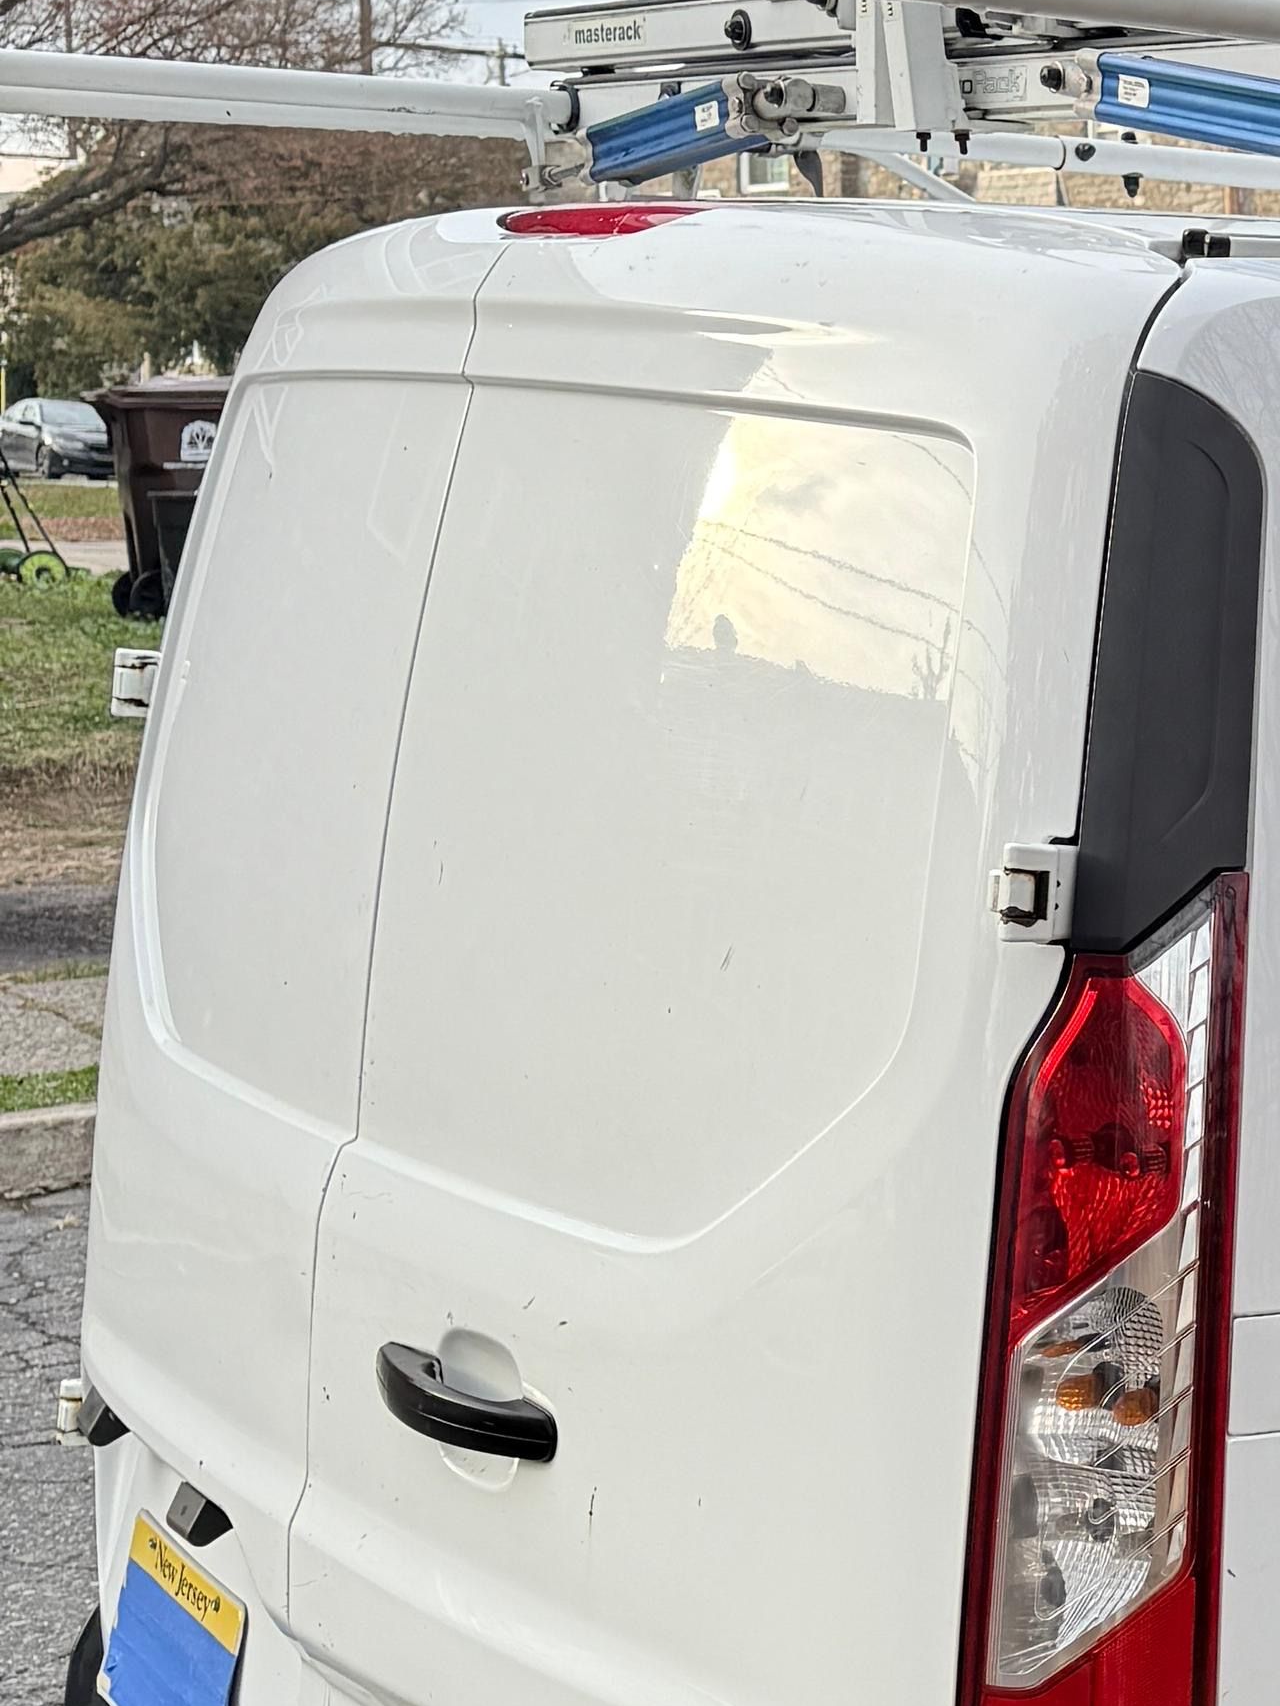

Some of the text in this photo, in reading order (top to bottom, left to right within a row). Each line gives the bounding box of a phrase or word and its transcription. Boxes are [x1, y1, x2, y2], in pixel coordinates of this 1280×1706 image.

[574, 19, 642, 44] masterack
[154, 1539, 213, 1622] New Jersey
